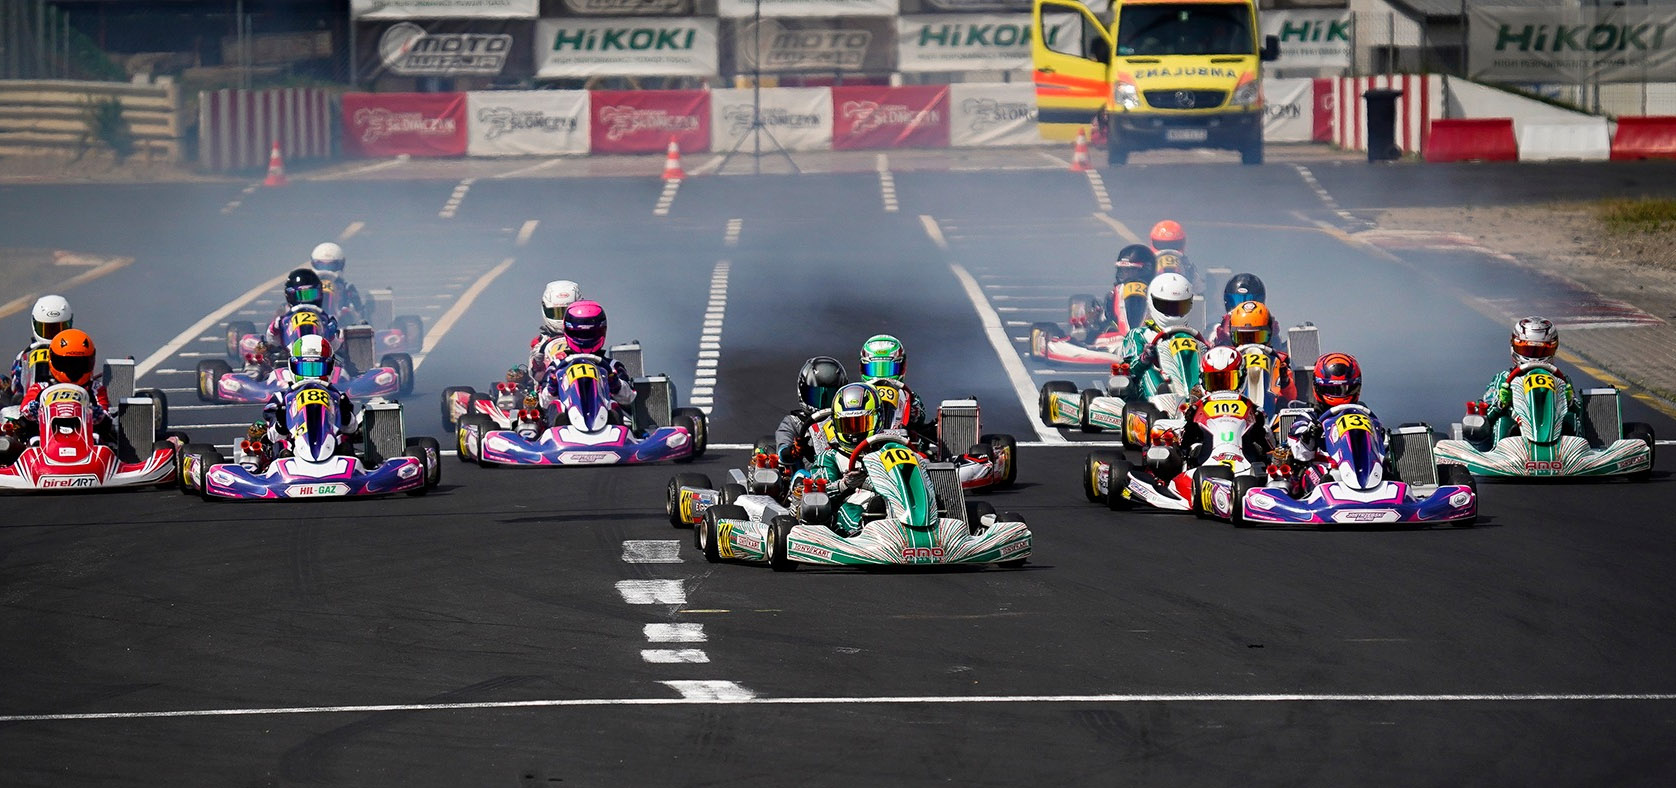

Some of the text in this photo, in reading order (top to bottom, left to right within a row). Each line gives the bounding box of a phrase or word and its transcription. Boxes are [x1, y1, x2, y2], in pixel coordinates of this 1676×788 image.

[553, 28, 696, 51] HiKOKI
[1495, 24, 1666, 51] HiKOKI
[31, 350, 50, 362] 11
[568, 364, 598, 379] 111
[1525, 374, 1557, 390] 163
[298, 390, 331, 405] 188
[1213, 403, 1240, 414] 102
[884, 449, 917, 462] 10
